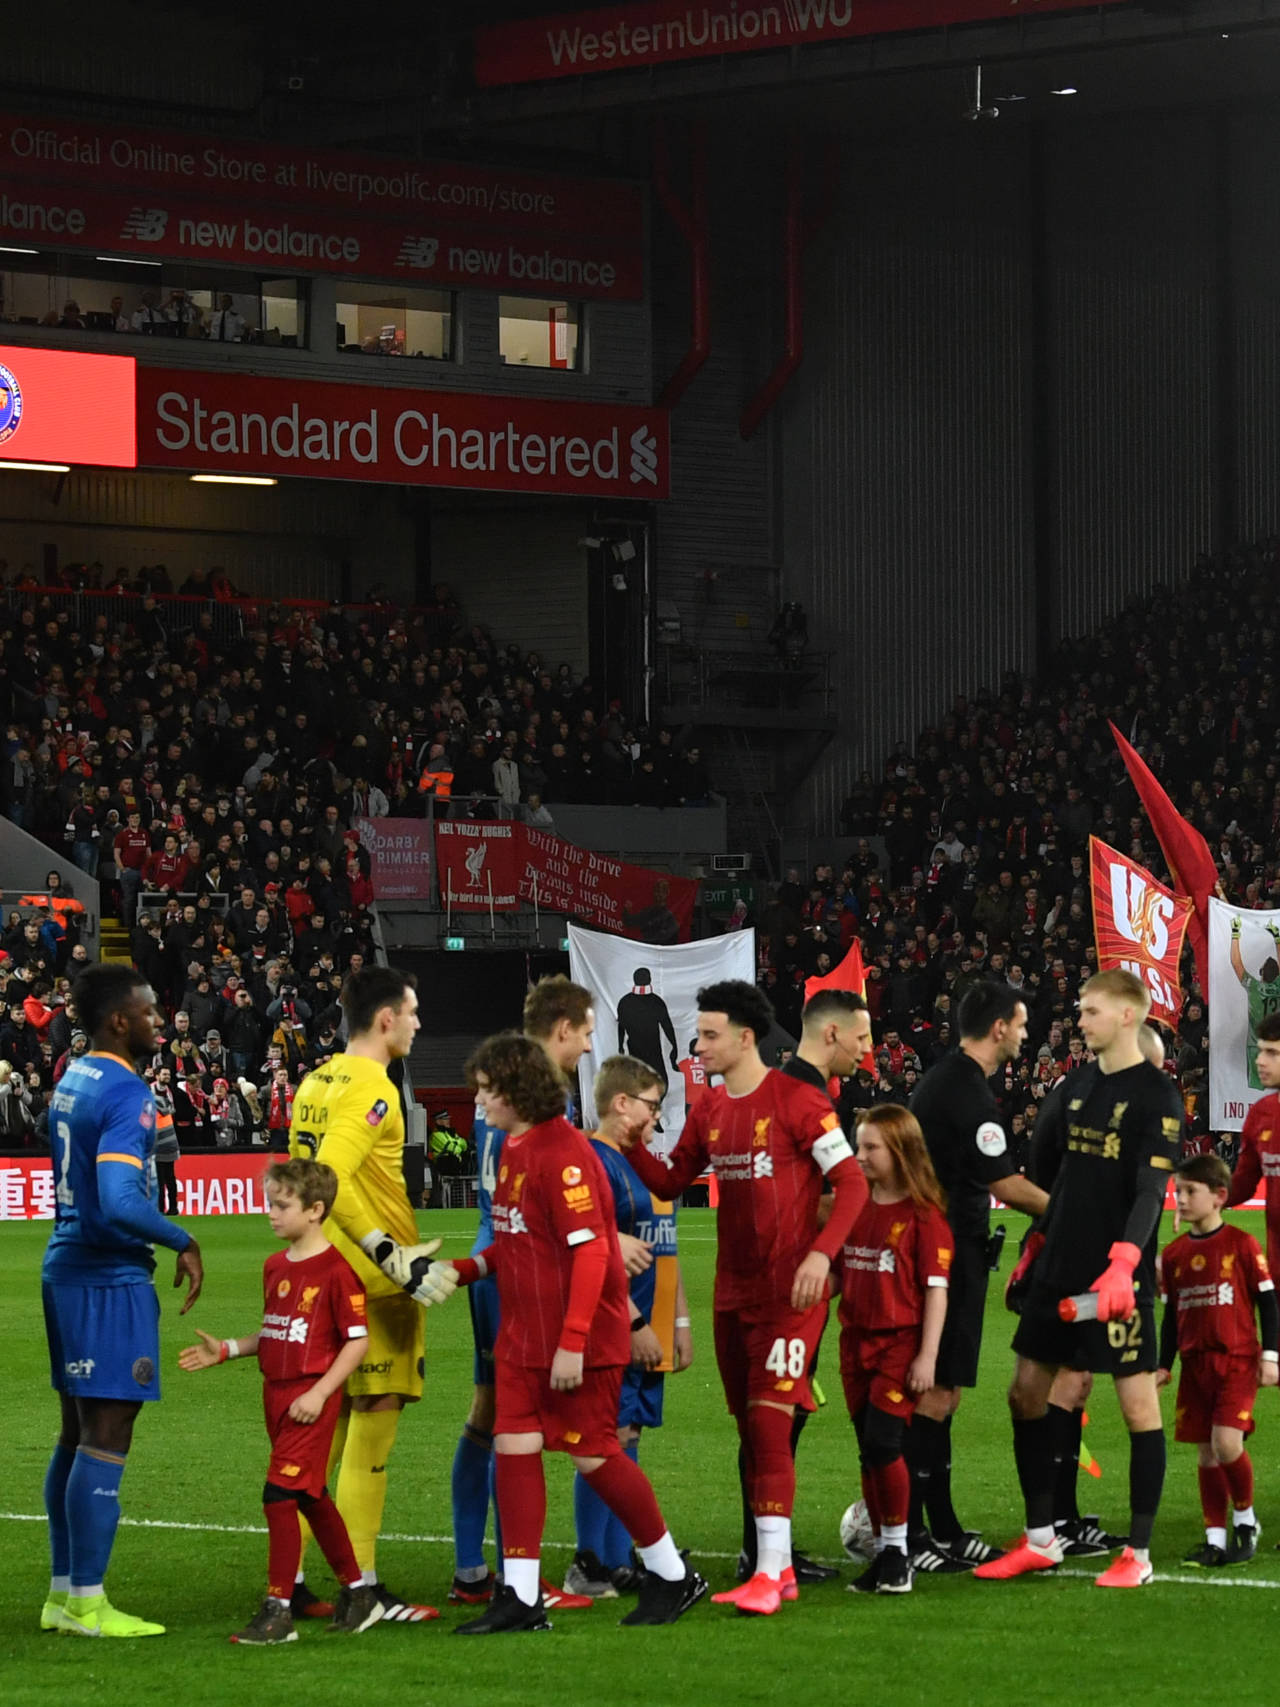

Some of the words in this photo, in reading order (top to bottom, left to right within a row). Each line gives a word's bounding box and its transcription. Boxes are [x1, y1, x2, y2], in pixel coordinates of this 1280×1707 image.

[546, 1, 782, 66] WesternUnion
[11, 128, 100, 164] Official
[110, 139, 195, 175] Online
[203, 149, 267, 183] Store
[274, 163, 298, 187] at
[306, 162, 555, 215] liverpoolfc.com/store
[178, 219, 239, 249] new
[243, 219, 360, 262] balance
[448, 246, 502, 275] new
[507, 246, 617, 287] balance
[155, 391, 379, 464] Standard
[393, 410, 620, 479] Chartered
[377, 836, 421, 849] DARBY
[377, 851, 431, 865] RIMMER
[692, 1069, 705, 1085] 12
[1107, 1307, 1143, 1349] 62
[765, 1337, 807, 1379] 48
